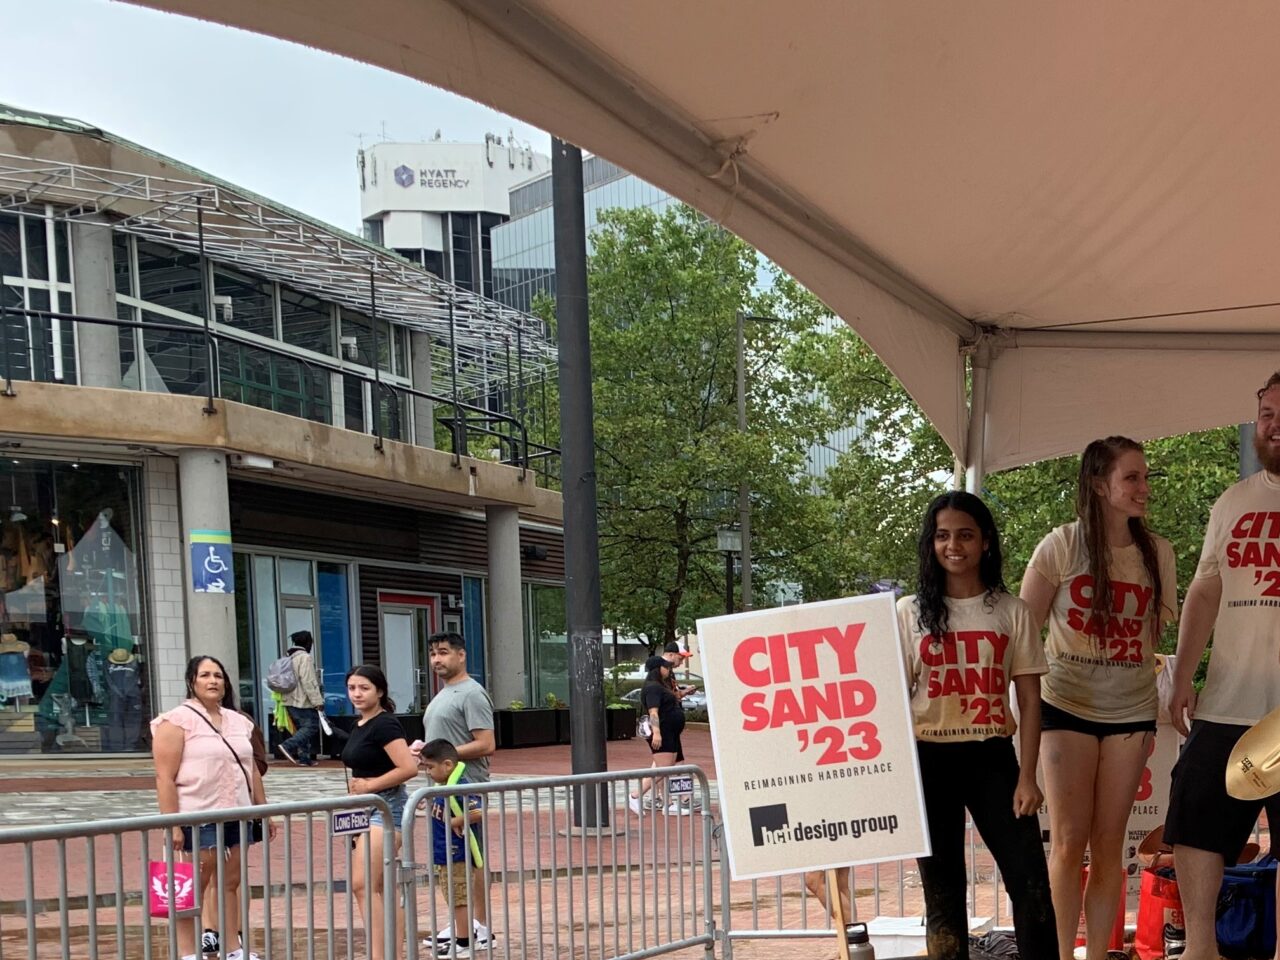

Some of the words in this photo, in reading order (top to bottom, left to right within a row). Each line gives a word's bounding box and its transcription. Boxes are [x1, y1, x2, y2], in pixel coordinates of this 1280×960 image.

[420, 169, 456, 178] HYATT
[420, 179, 469, 188] REGENCY
[1069, 574, 1153, 617] CTY
[733, 623, 867, 688] CITY
[920, 630, 1010, 667] CITY
[927, 666, 1007, 699] SAND
[740, 679, 877, 732] SAND
[959, 696, 1007, 725] '23
[797, 721, 882, 766] '23
[744, 772, 813, 791] REIMAGINING
[818, 762, 893, 781] HARBORPLACE
[793, 819, 847, 841] design
[850, 814, 899, 839] group
